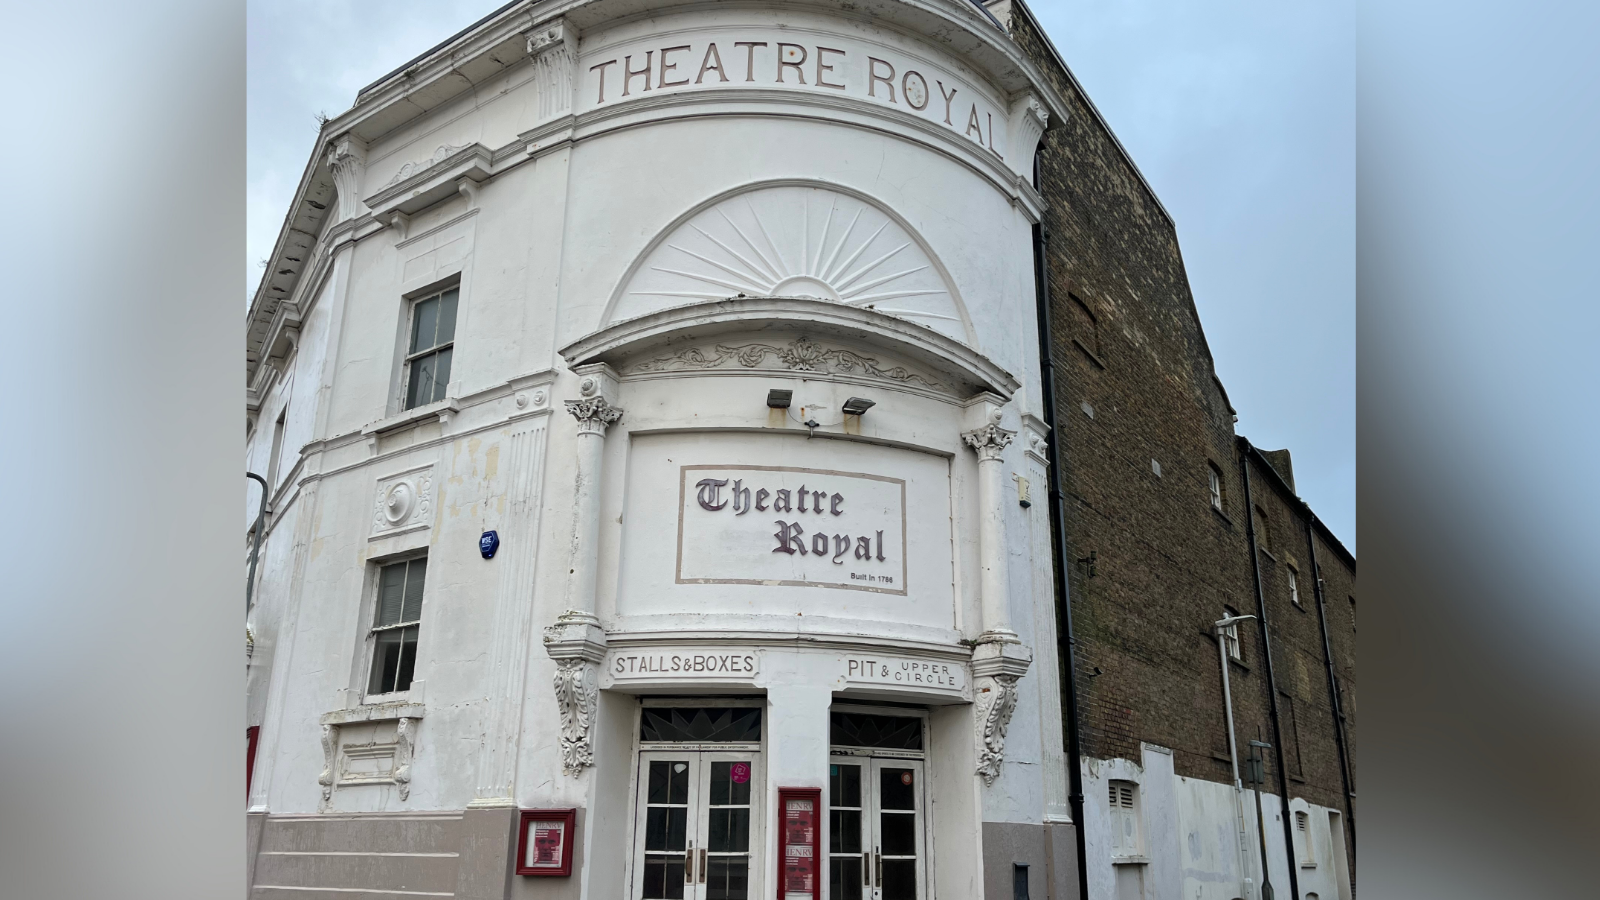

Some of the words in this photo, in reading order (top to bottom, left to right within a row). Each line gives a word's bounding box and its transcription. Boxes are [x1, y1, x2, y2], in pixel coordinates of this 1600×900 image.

[589, 42, 846, 104] THEATRE
[867, 55, 1004, 161] ROYAL
[695, 478, 844, 517] Theatre
[772, 520, 886, 565] Royal
[851, 572, 867, 580] Built
[848, 659, 877, 677] PIT
[881, 665, 889, 677] &
[902, 662, 949, 675] UPPER
[894, 671, 955, 686] CIRCLE
